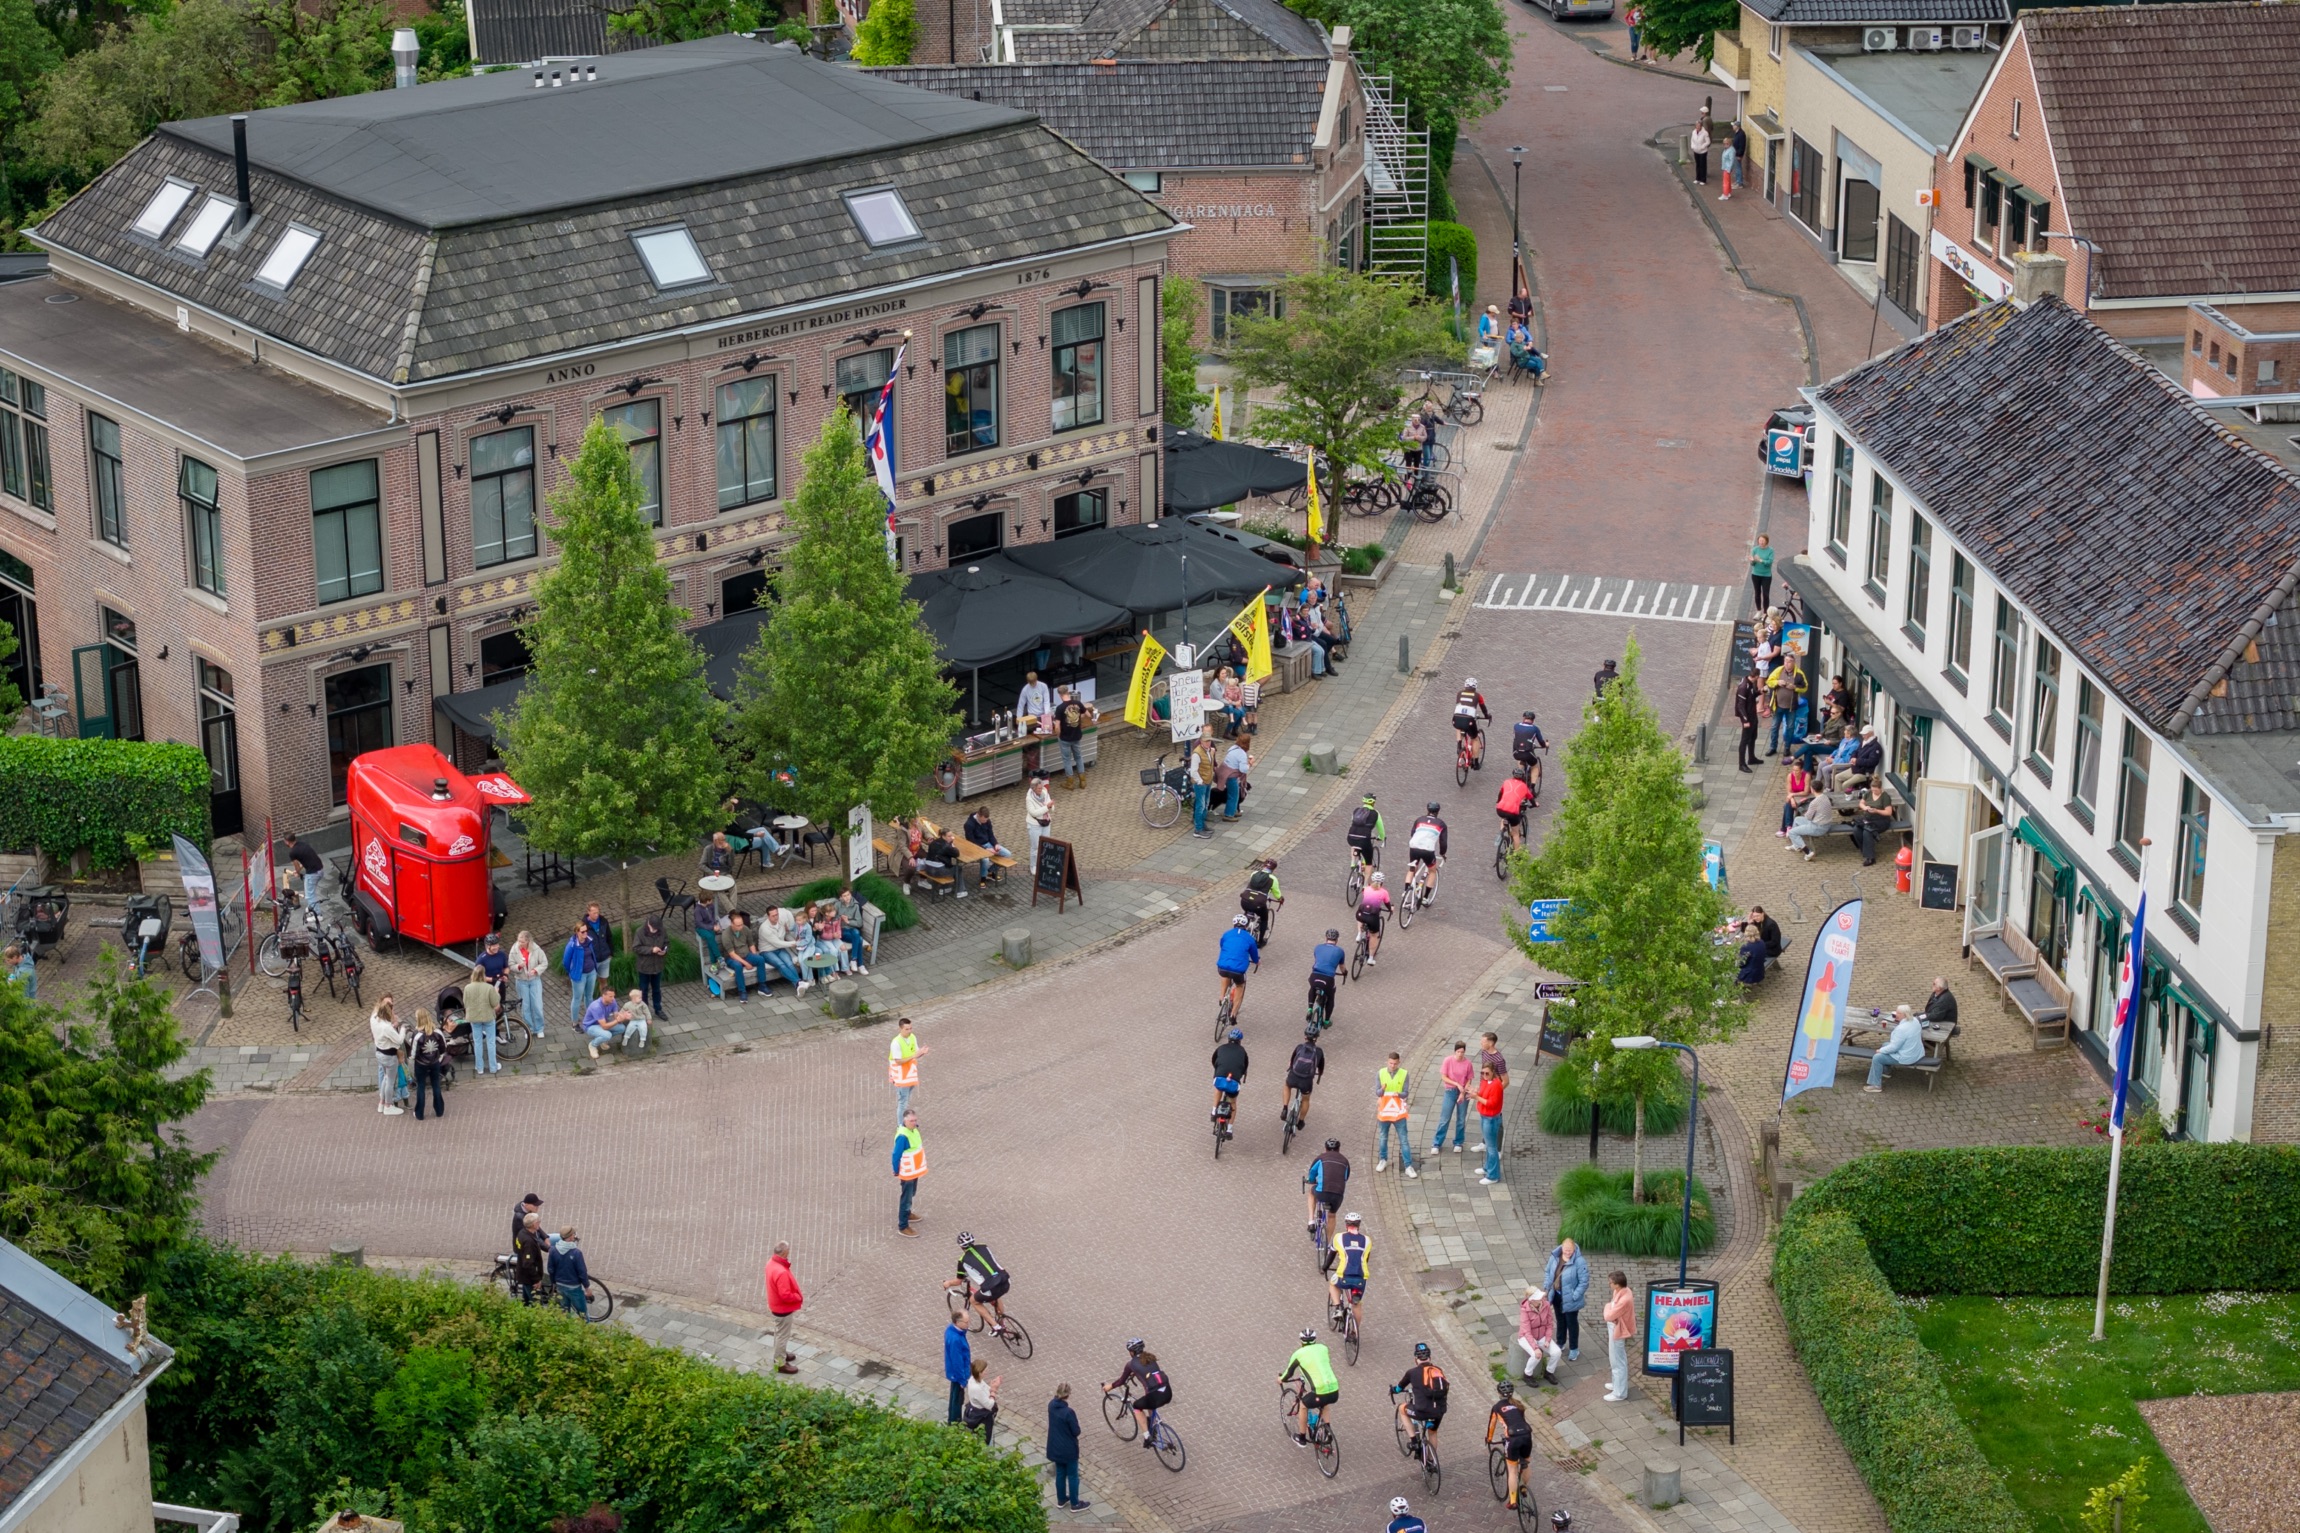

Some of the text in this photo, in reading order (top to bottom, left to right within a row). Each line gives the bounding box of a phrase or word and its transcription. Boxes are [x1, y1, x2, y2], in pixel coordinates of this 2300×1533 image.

[1018, 268, 1050, 284] 1876
[718, 299, 907, 348] HERBERGH IT READE HYNDER
[546, 364, 595, 384] ANNO
[1173, 724, 1196, 737] WC
[1655, 1295, 1711, 1307] HEAMIEL
